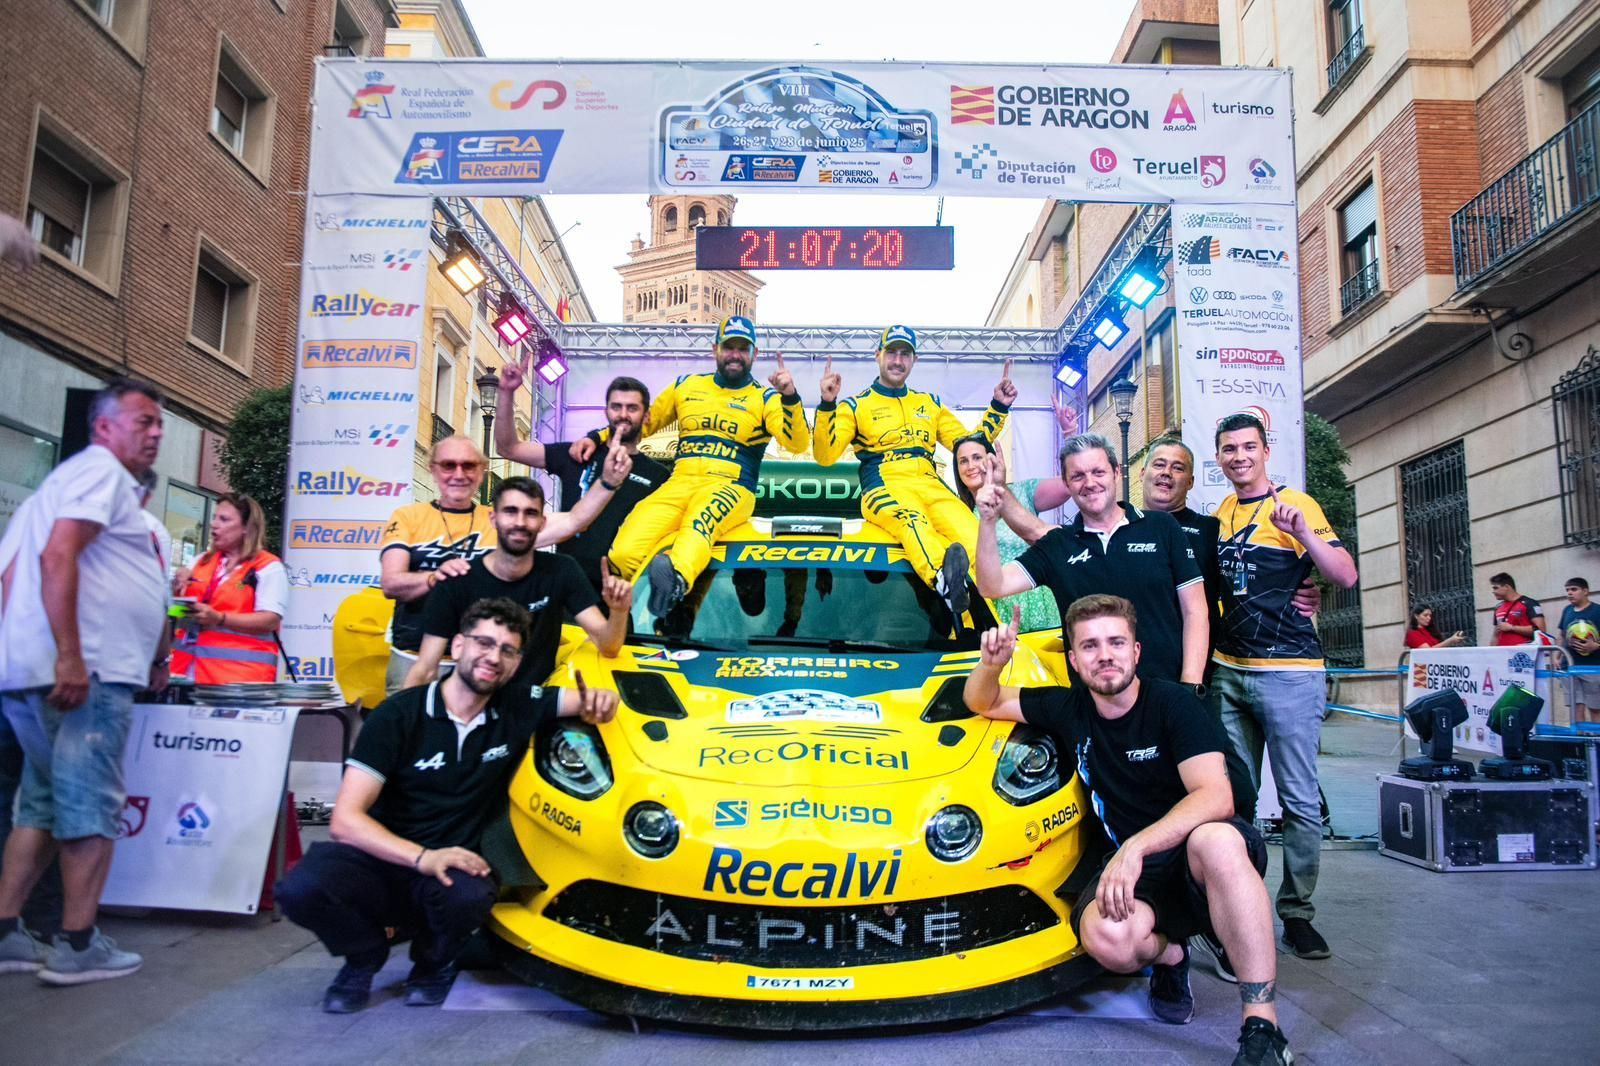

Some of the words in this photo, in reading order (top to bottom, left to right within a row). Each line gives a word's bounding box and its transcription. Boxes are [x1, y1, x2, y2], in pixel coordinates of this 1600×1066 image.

[400, 87, 422, 98] Real
[778, 84, 810, 97] VIII
[997, 85, 1130, 108] GOBIERNO
[408, 98, 451, 110] Española
[453, 98, 465, 108] de
[1212, 101, 1274, 117] turismo
[400, 109, 472, 121] Automovilismo
[998, 107, 1032, 126] DE
[1041, 108, 1149, 130] ARAGON
[708, 117, 785, 131] Ciudad
[787, 118, 811, 129] de
[820, 117, 883, 131] Teruel
[457, 136, 542, 153] CERA
[753, 137, 767, 147] 27
[770, 139, 778, 150] y
[780, 137, 794, 147] 28
[798, 137, 814, 147] de
[815, 137, 848, 150] junio
[851, 138, 865, 148] 25
[473, 163, 526, 177] Recalvi
[997, 160, 1076, 175] Diputación
[1133, 157, 1198, 175] Teruel
[997, 172, 1015, 184] de
[1021, 173, 1066, 185] Teruel
[342, 218, 428, 229] MICHELIN
[740, 230, 903, 267] 21:07:20
[1187, 266, 1212, 276] fada
[312, 293, 420, 317] Rallycar
[323, 344, 393, 363] Recalvi
[1196, 347, 1218, 360] sin
[1221, 349, 1283, 364] sponsor.es
[327, 391, 414, 403] MICHELIN
[297, 471, 408, 497] Rallycar
[308, 525, 382, 544] Recalvi
[737, 545, 877, 563] Recalvi
[314, 574, 381, 585] MICHEL
[286, 656, 334, 676] Rall
[716, 656, 900, 670] TORREIRO
[1427, 663, 1471, 679] GOBIERNO
[715, 670, 848, 678] RECAMBIOS
[1428, 678, 1439, 690] DE
[1472, 705, 1489, 716] Teru
[153, 731, 242, 753] turismo
[698, 742, 909, 770] RecOficial
[1126, 746, 1158, 758] TRS
[541, 802, 581, 836] RADSA
[1042, 802, 1079, 833] RADSA
[703, 847, 903, 899] Recalvi
[645, 909, 963, 951] ALPINE
[760, 978, 801, 988] 7671
[809, 979, 849, 988] MZY
